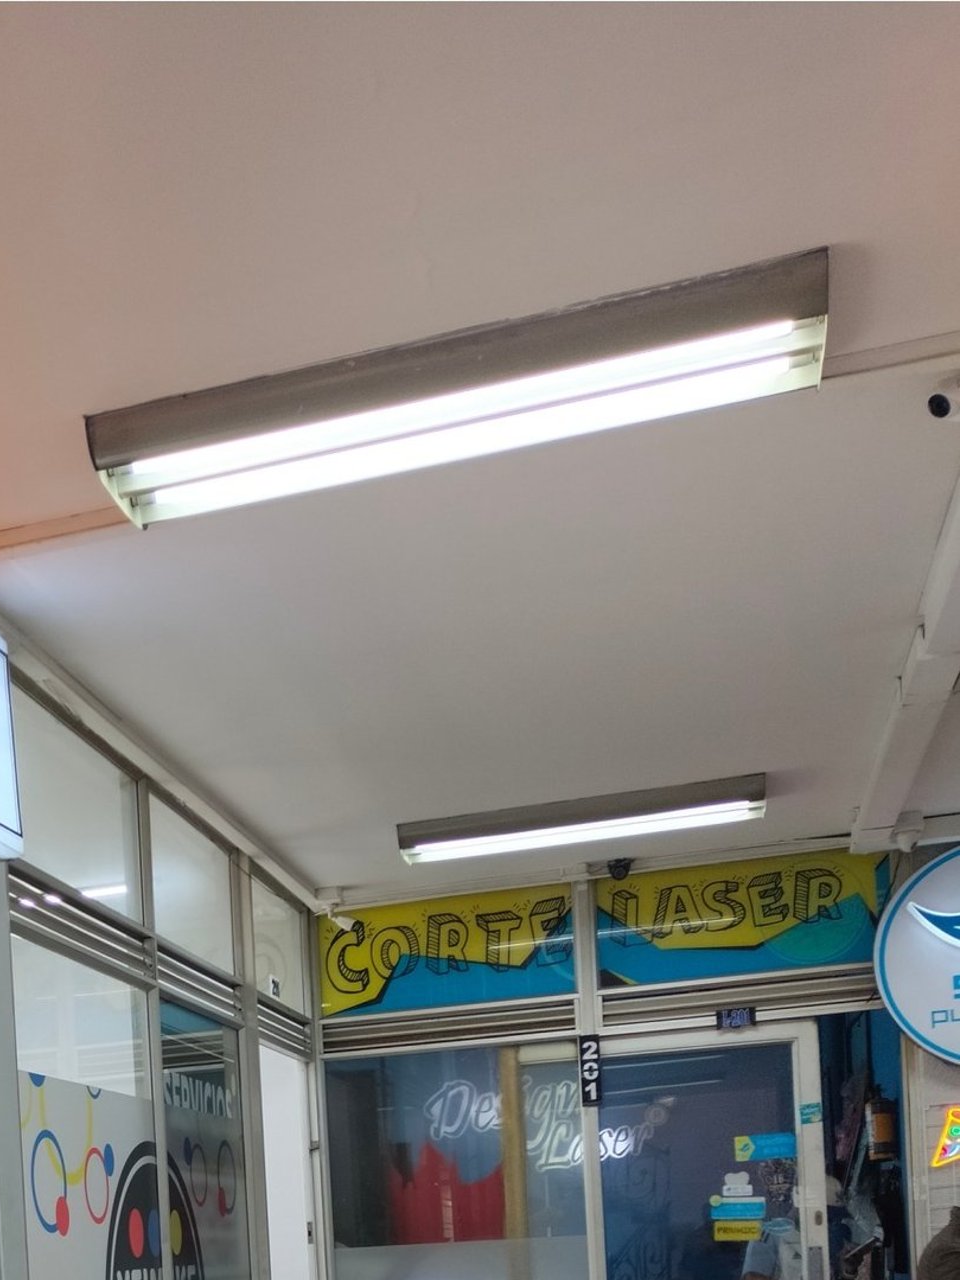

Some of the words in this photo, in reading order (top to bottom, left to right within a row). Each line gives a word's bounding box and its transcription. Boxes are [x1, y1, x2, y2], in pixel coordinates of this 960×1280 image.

[326, 896, 574, 994] CORTE
[610, 868, 841, 948] LASER
[581, 1041, 600, 1101] 201
